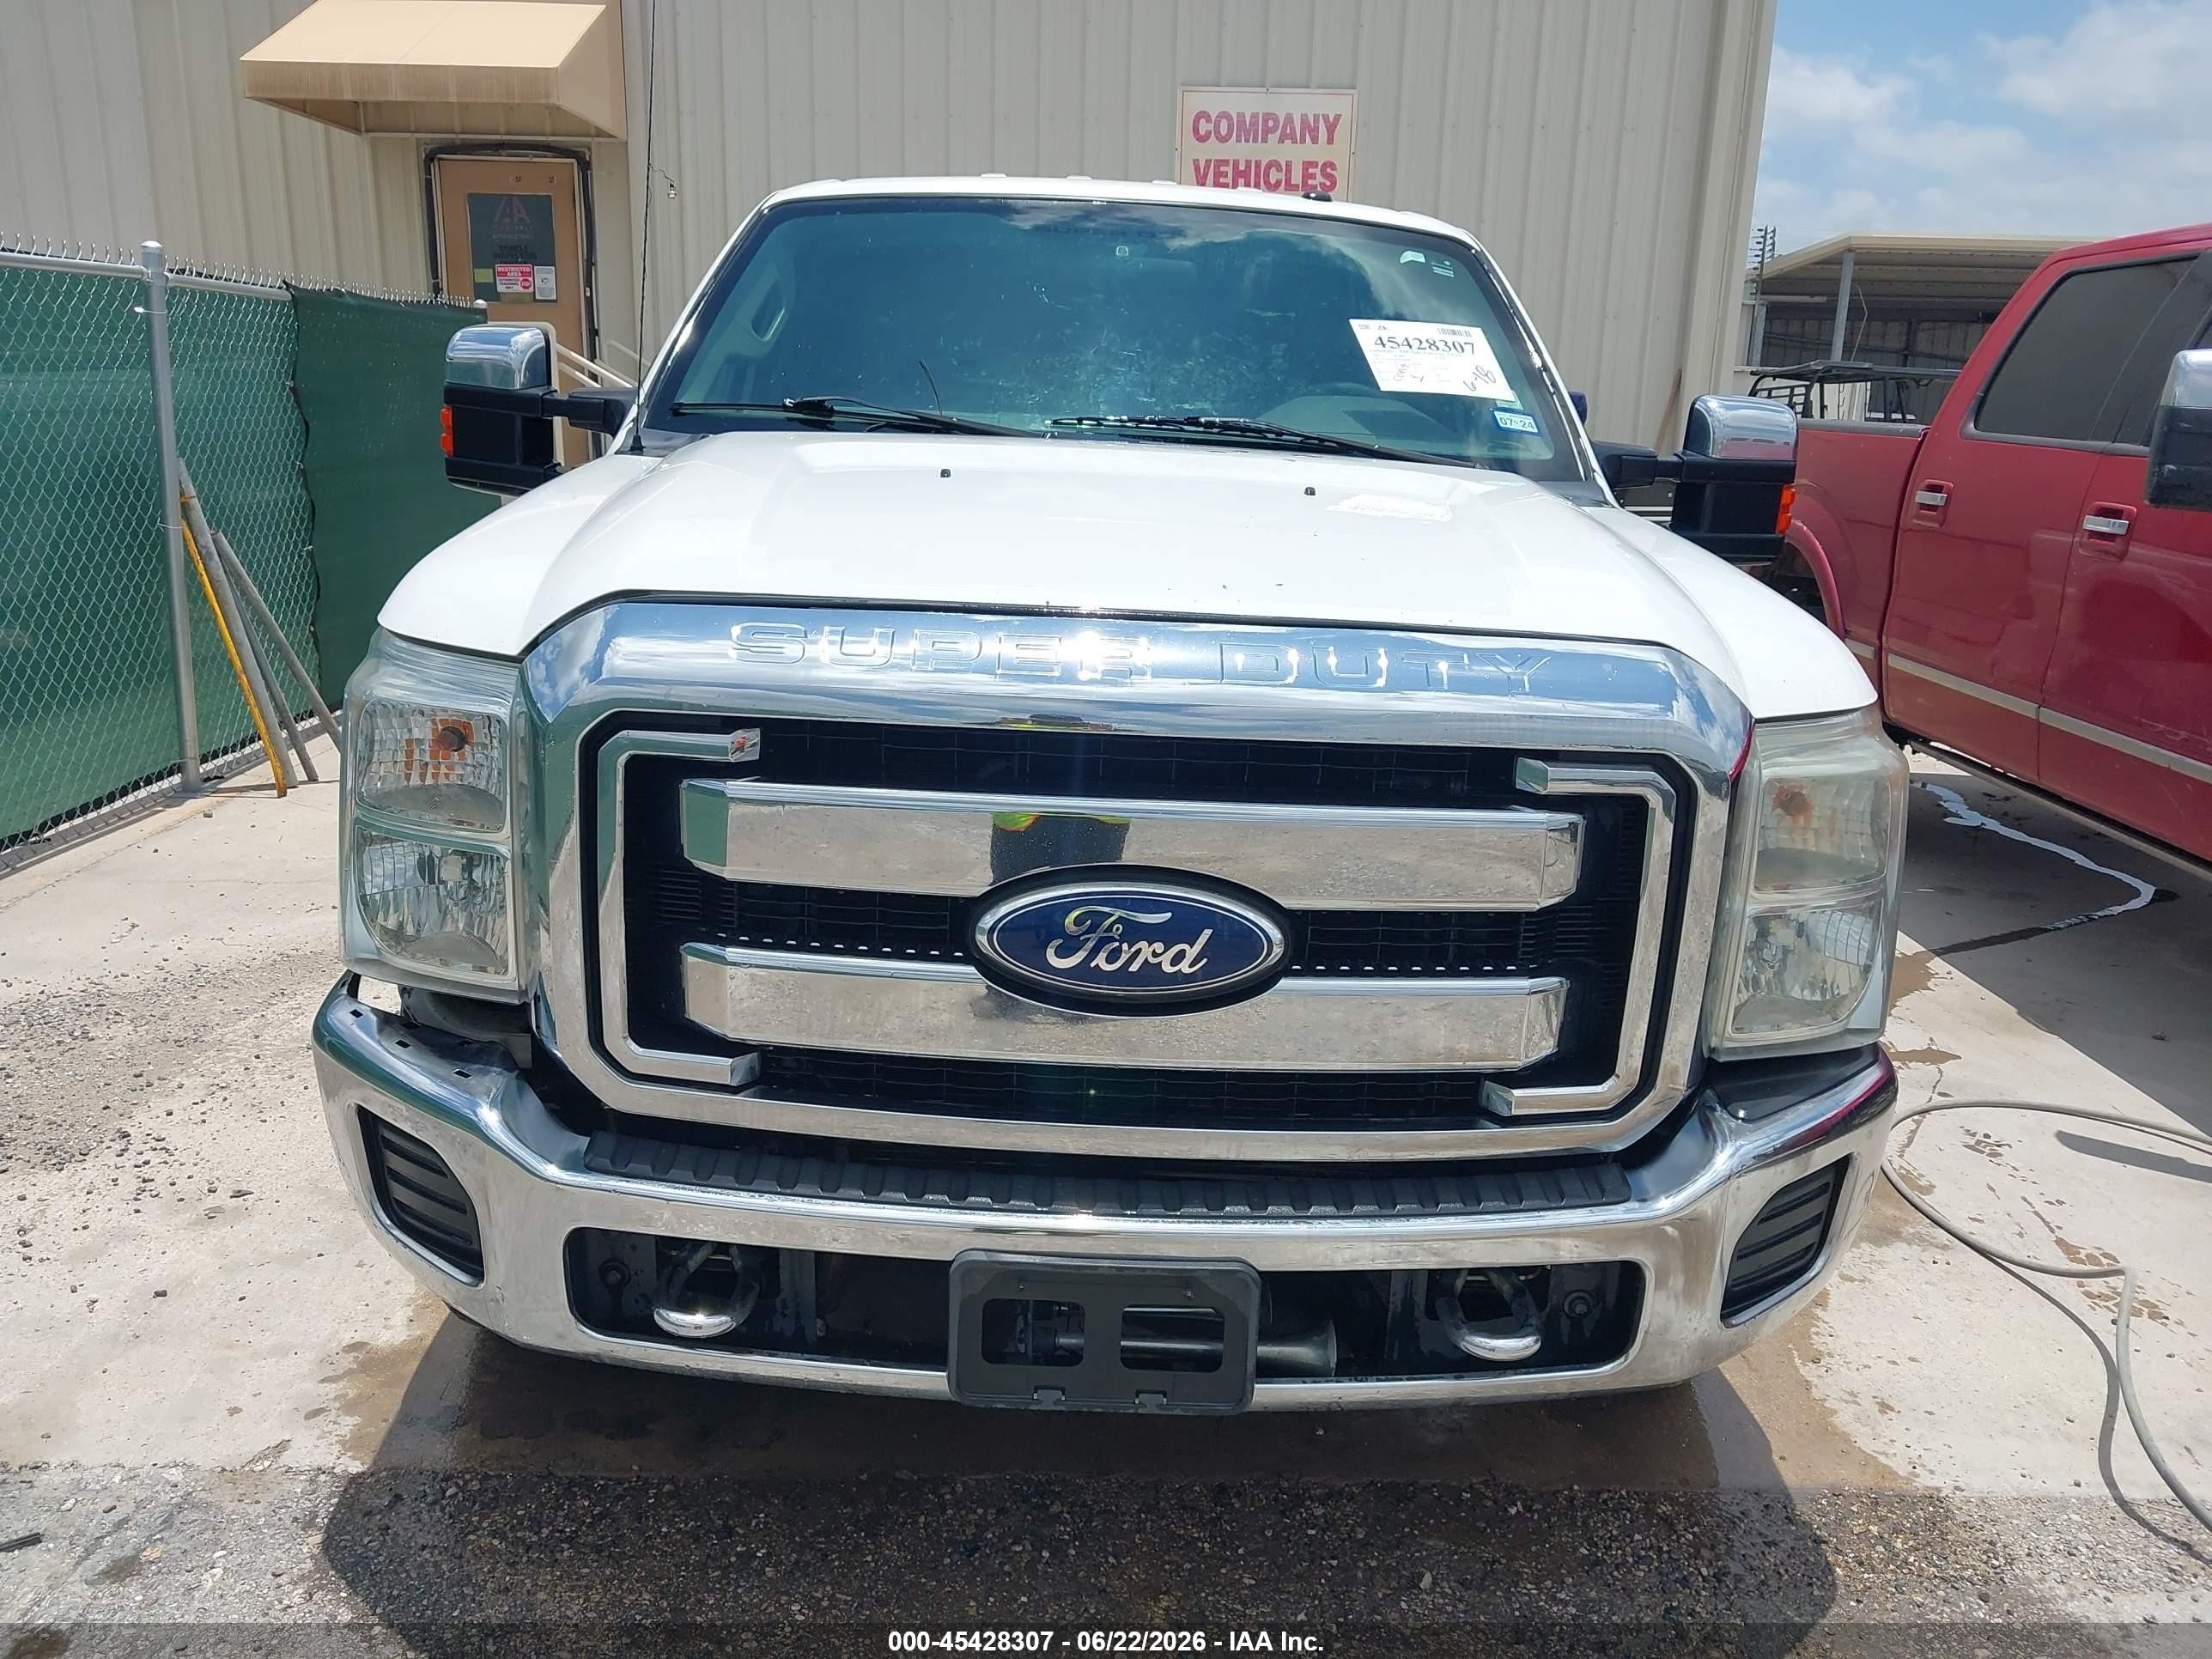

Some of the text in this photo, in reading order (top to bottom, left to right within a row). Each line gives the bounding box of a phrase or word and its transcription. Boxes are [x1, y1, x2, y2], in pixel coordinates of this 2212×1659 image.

[1192, 110, 1343, 145] COMPANY
[1192, 158, 1339, 193] VEHICLES
[1374, 336, 1474, 355] 45428307
[728, 622, 1553, 696] SUPER DUTY
[1045, 905, 1214, 975] Ford
